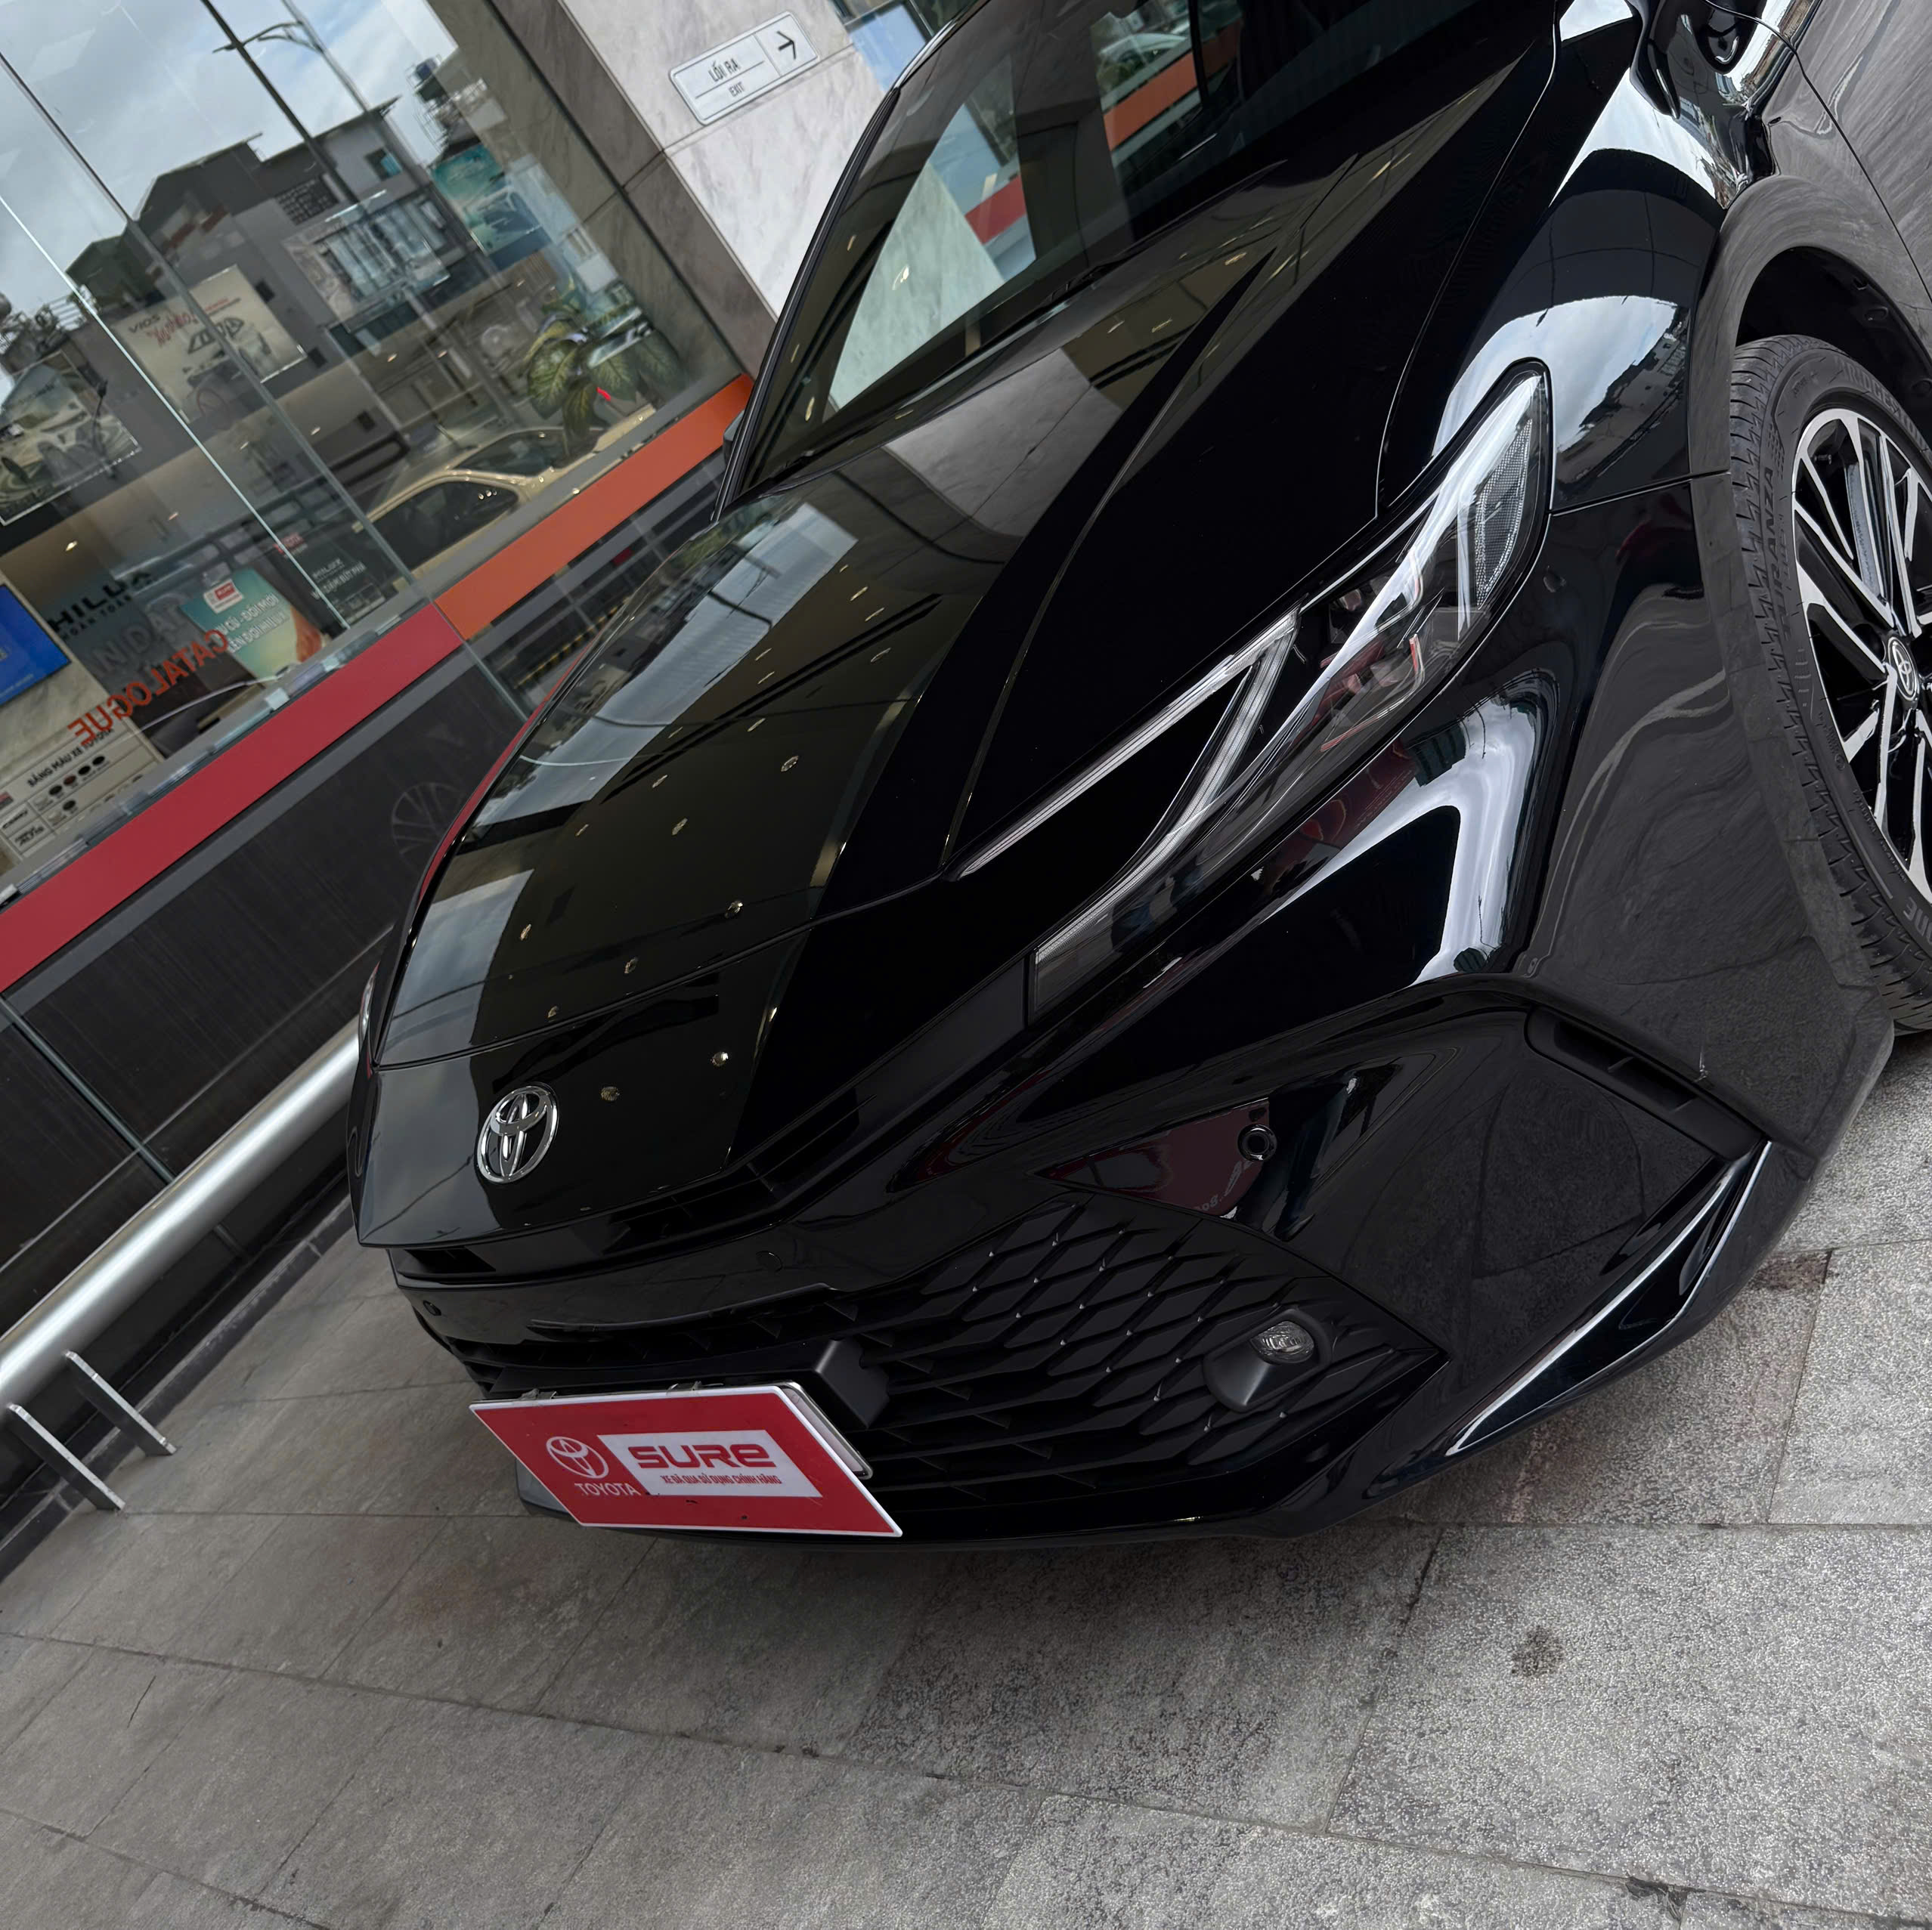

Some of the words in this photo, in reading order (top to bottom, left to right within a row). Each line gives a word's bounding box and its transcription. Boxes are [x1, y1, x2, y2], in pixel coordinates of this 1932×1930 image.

[707, 60, 727, 82] LỐI
[723, 58, 741, 76] RA
[728, 81, 745, 97] EXIT
[1764, 466, 1790, 642] TURANZA
[660, 1475, 674, 1484] XE
[671, 1474, 685, 1484] ĐÃ
[682, 1475, 701, 1484] QUA
[709, 1475, 735, 1486] DỤNG
[732, 1473, 760, 1484] CHÍNH
[757, 1473, 782, 1484] HÃNG
[574, 1483, 641, 1495] TOYOTA
